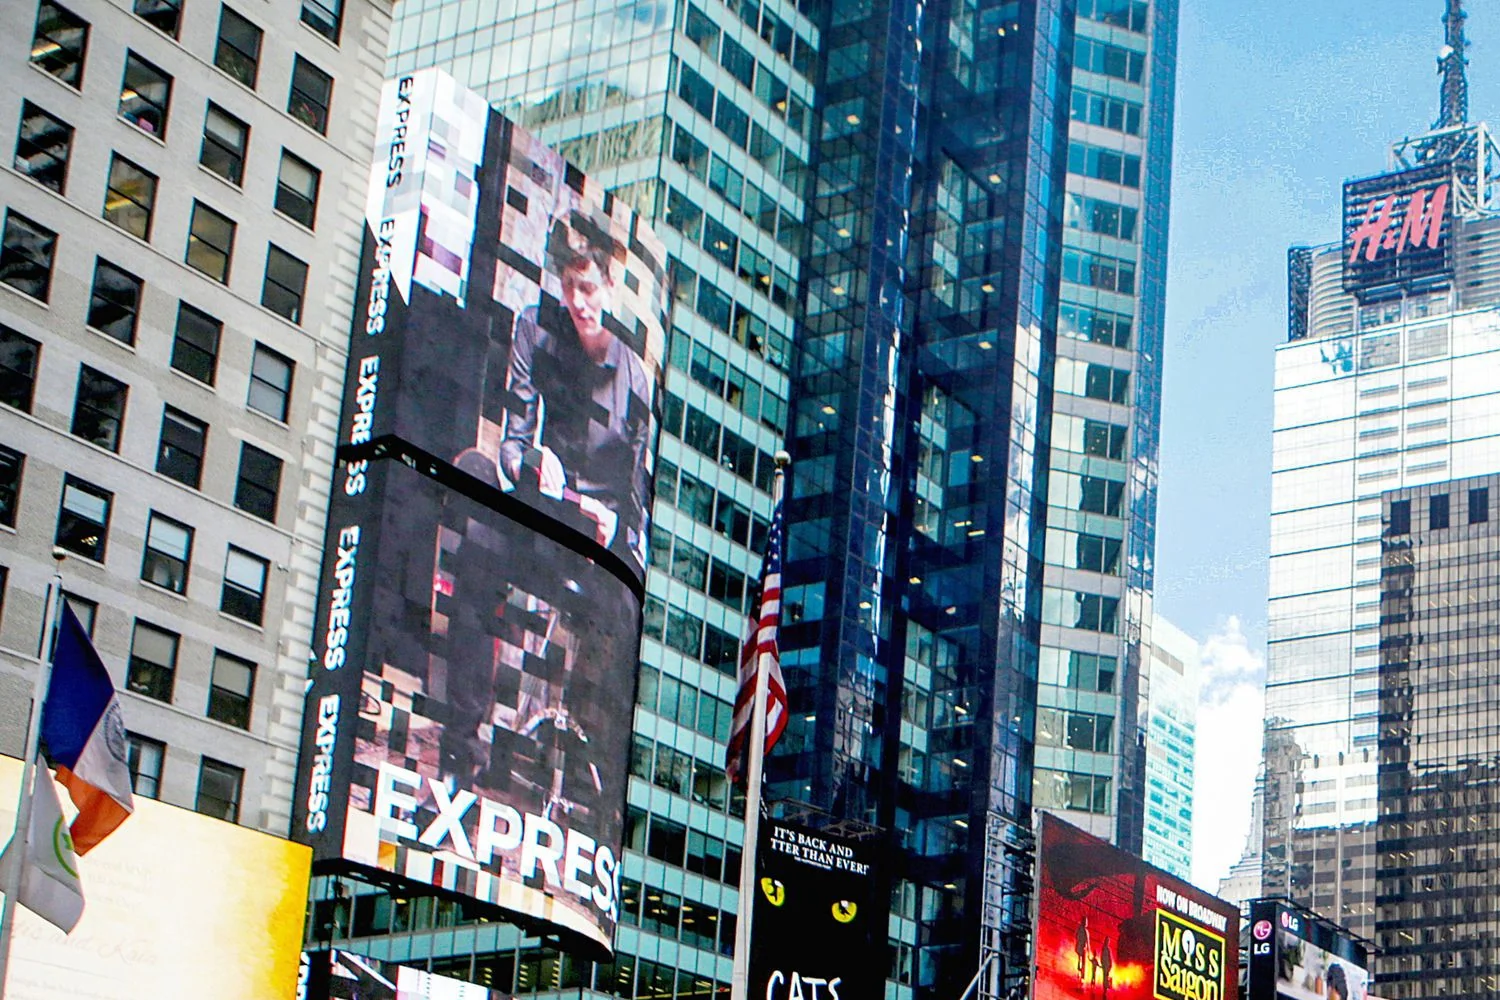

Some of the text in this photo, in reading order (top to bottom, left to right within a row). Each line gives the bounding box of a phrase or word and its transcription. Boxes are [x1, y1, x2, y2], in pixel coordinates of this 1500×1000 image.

[385, 76, 415, 189] EXPRESS
[1350, 183, 1449, 263] H&M
[366, 216, 399, 338] EXPRESS
[323, 524, 362, 671] EXPRESS
[304, 693, 341, 834] EXPRESS
[774, 825, 854, 859] IT'S BACK AND
[801, 847, 834, 866] THAN
[1156, 884, 1176, 910] NOW
[1188, 899, 1228, 933] BROADWAY
[1289, 914, 1299, 932] LG
[1253, 943, 1271, 955] LG
